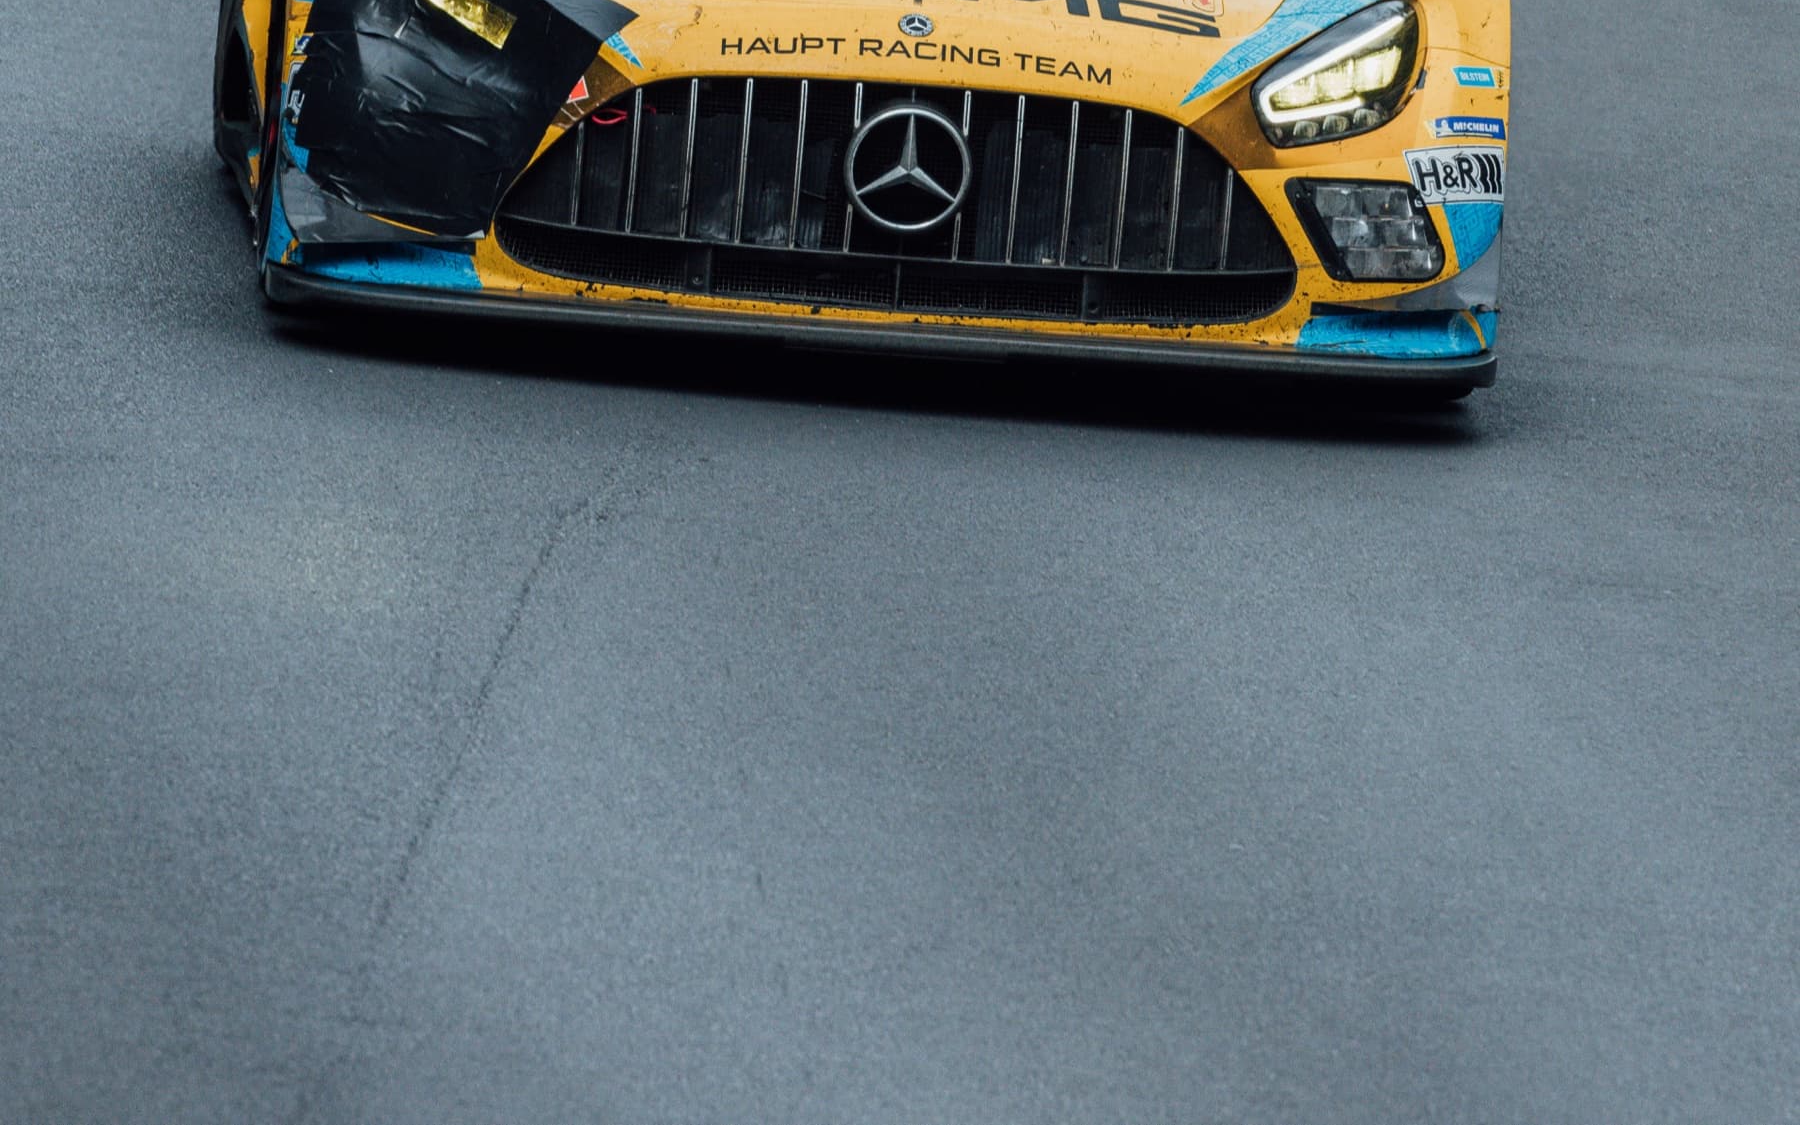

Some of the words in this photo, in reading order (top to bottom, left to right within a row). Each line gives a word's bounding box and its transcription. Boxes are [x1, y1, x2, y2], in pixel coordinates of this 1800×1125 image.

[720, 38, 846, 56] HAUPT
[859, 38, 1001, 67] RACING
[1014, 52, 1112, 85] TEAM
[1452, 121, 1500, 133] MICHELIN
[1414, 154, 1479, 192] H&R
